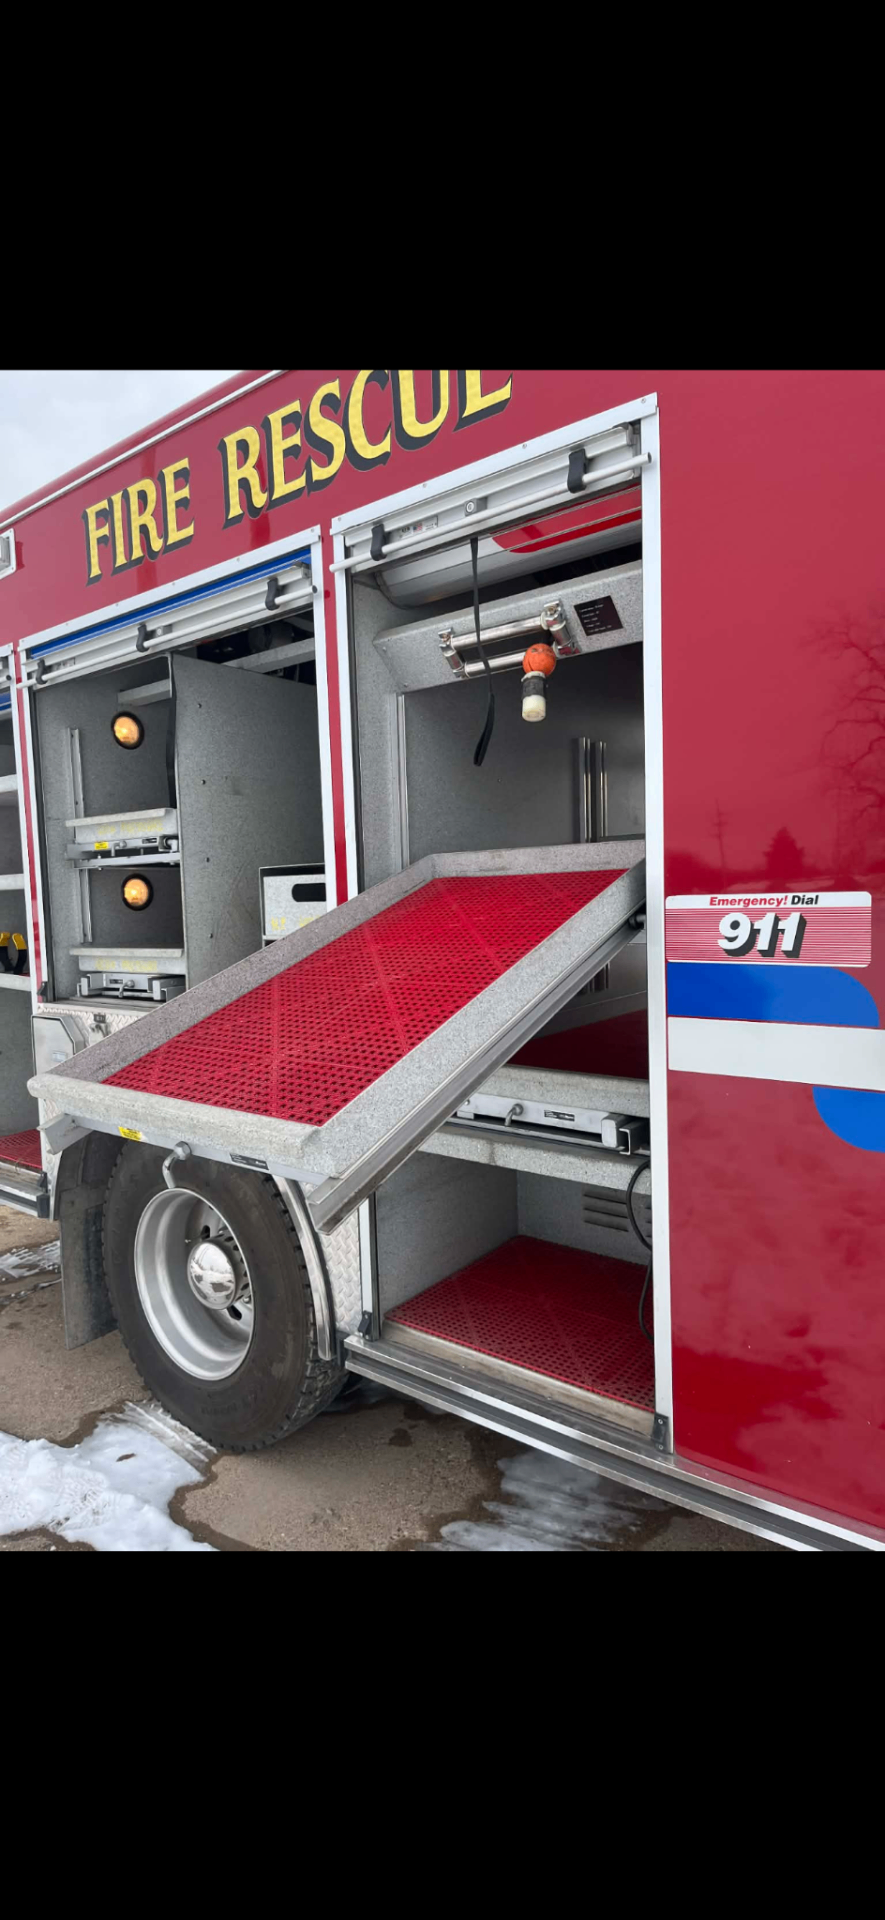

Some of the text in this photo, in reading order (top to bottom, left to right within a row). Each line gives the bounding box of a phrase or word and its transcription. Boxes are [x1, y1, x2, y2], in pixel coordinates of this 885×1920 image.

[82, 457, 194, 587] FIRE
[709, 895, 819, 908] Emergency! Dial
[717, 912, 807, 958] 911
